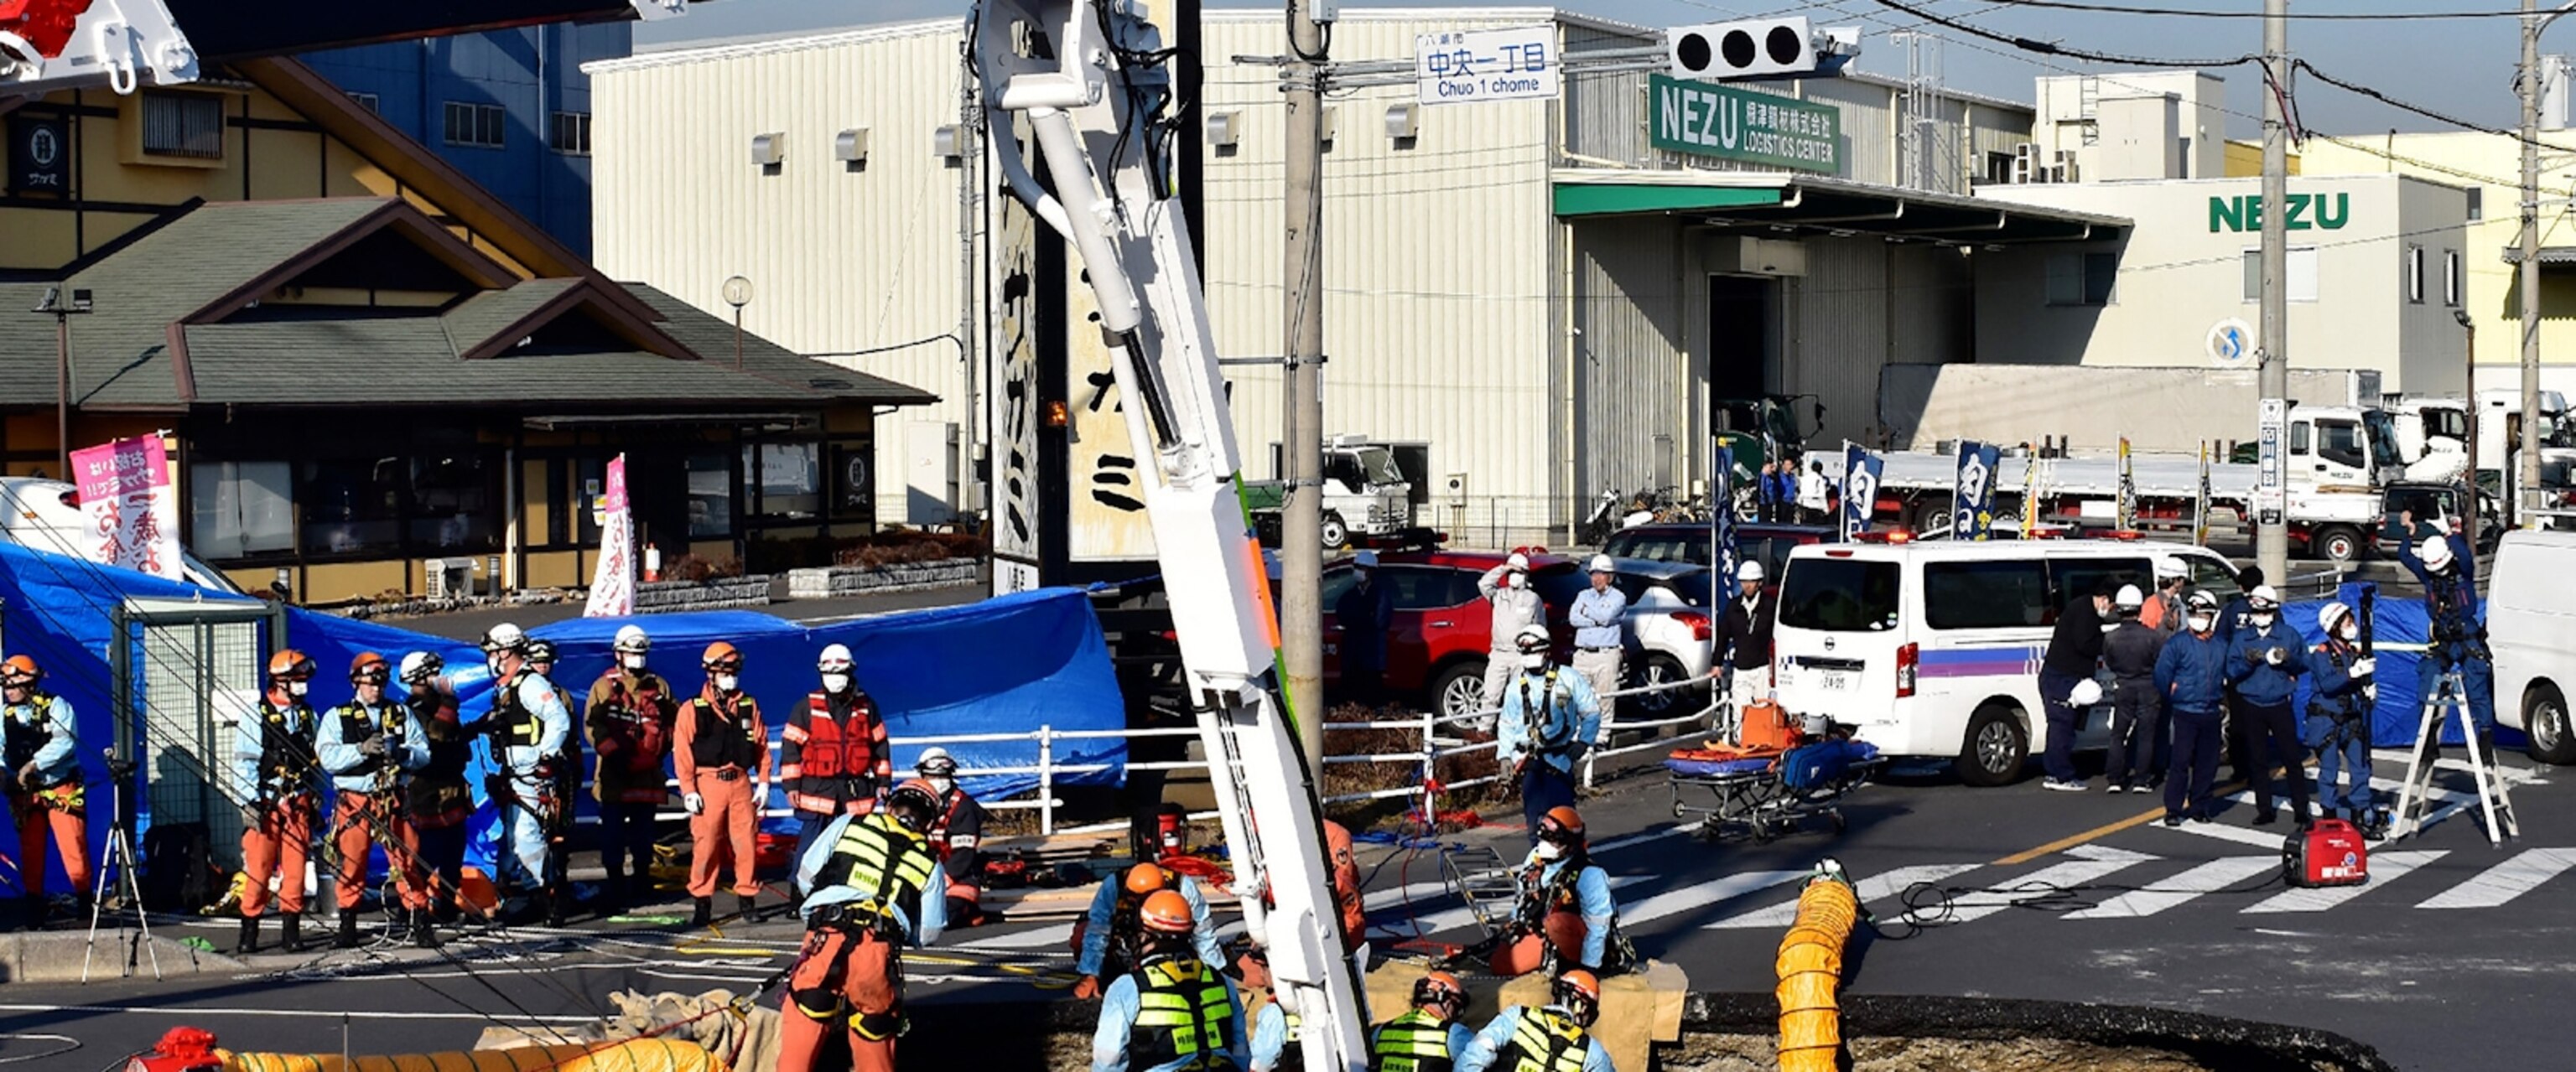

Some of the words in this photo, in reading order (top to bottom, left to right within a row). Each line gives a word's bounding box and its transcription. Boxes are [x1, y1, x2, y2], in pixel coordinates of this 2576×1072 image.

[1428, 43, 1545, 79] 中央一丁目
[1438, 80, 1474, 96] Chuo
[1480, 79, 1487, 94] 1
[1492, 77, 1539, 93] chome
[1661, 85, 1738, 150] NEZU
[1744, 130, 1795, 158] LOGISTICS
[1796, 136, 1833, 163] CENTER
